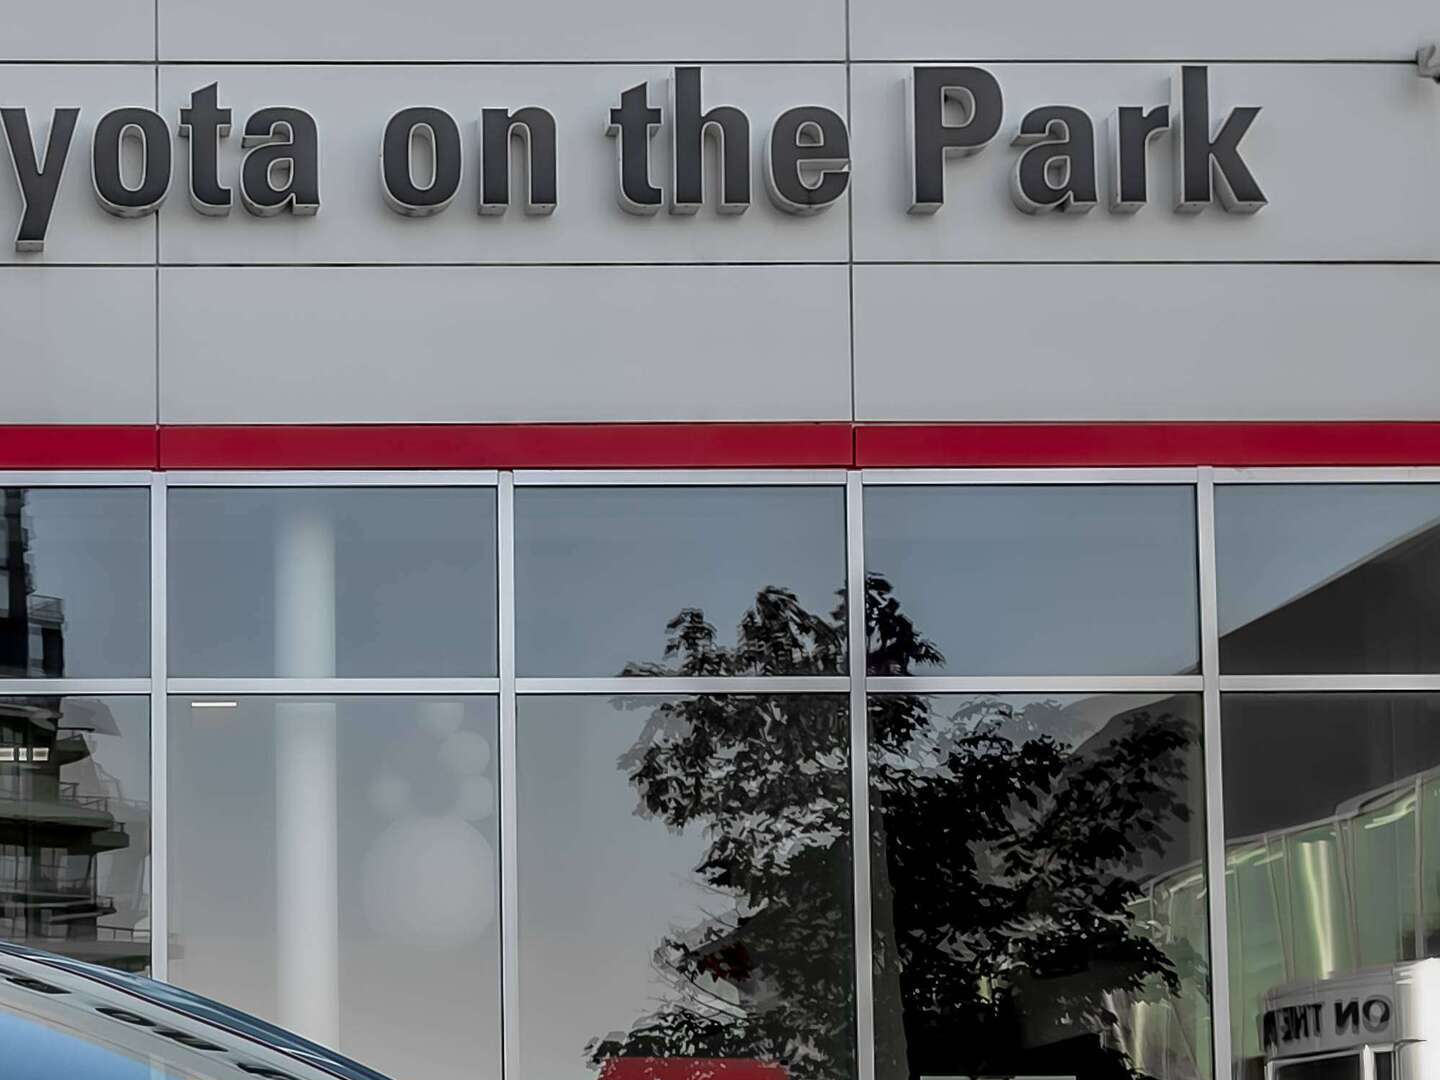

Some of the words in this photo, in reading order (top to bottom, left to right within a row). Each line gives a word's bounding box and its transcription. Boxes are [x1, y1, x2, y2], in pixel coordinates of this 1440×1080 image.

[380, 105, 559, 217] on
[606, 66, 852, 216] the
[905, 65, 1268, 215] Park
